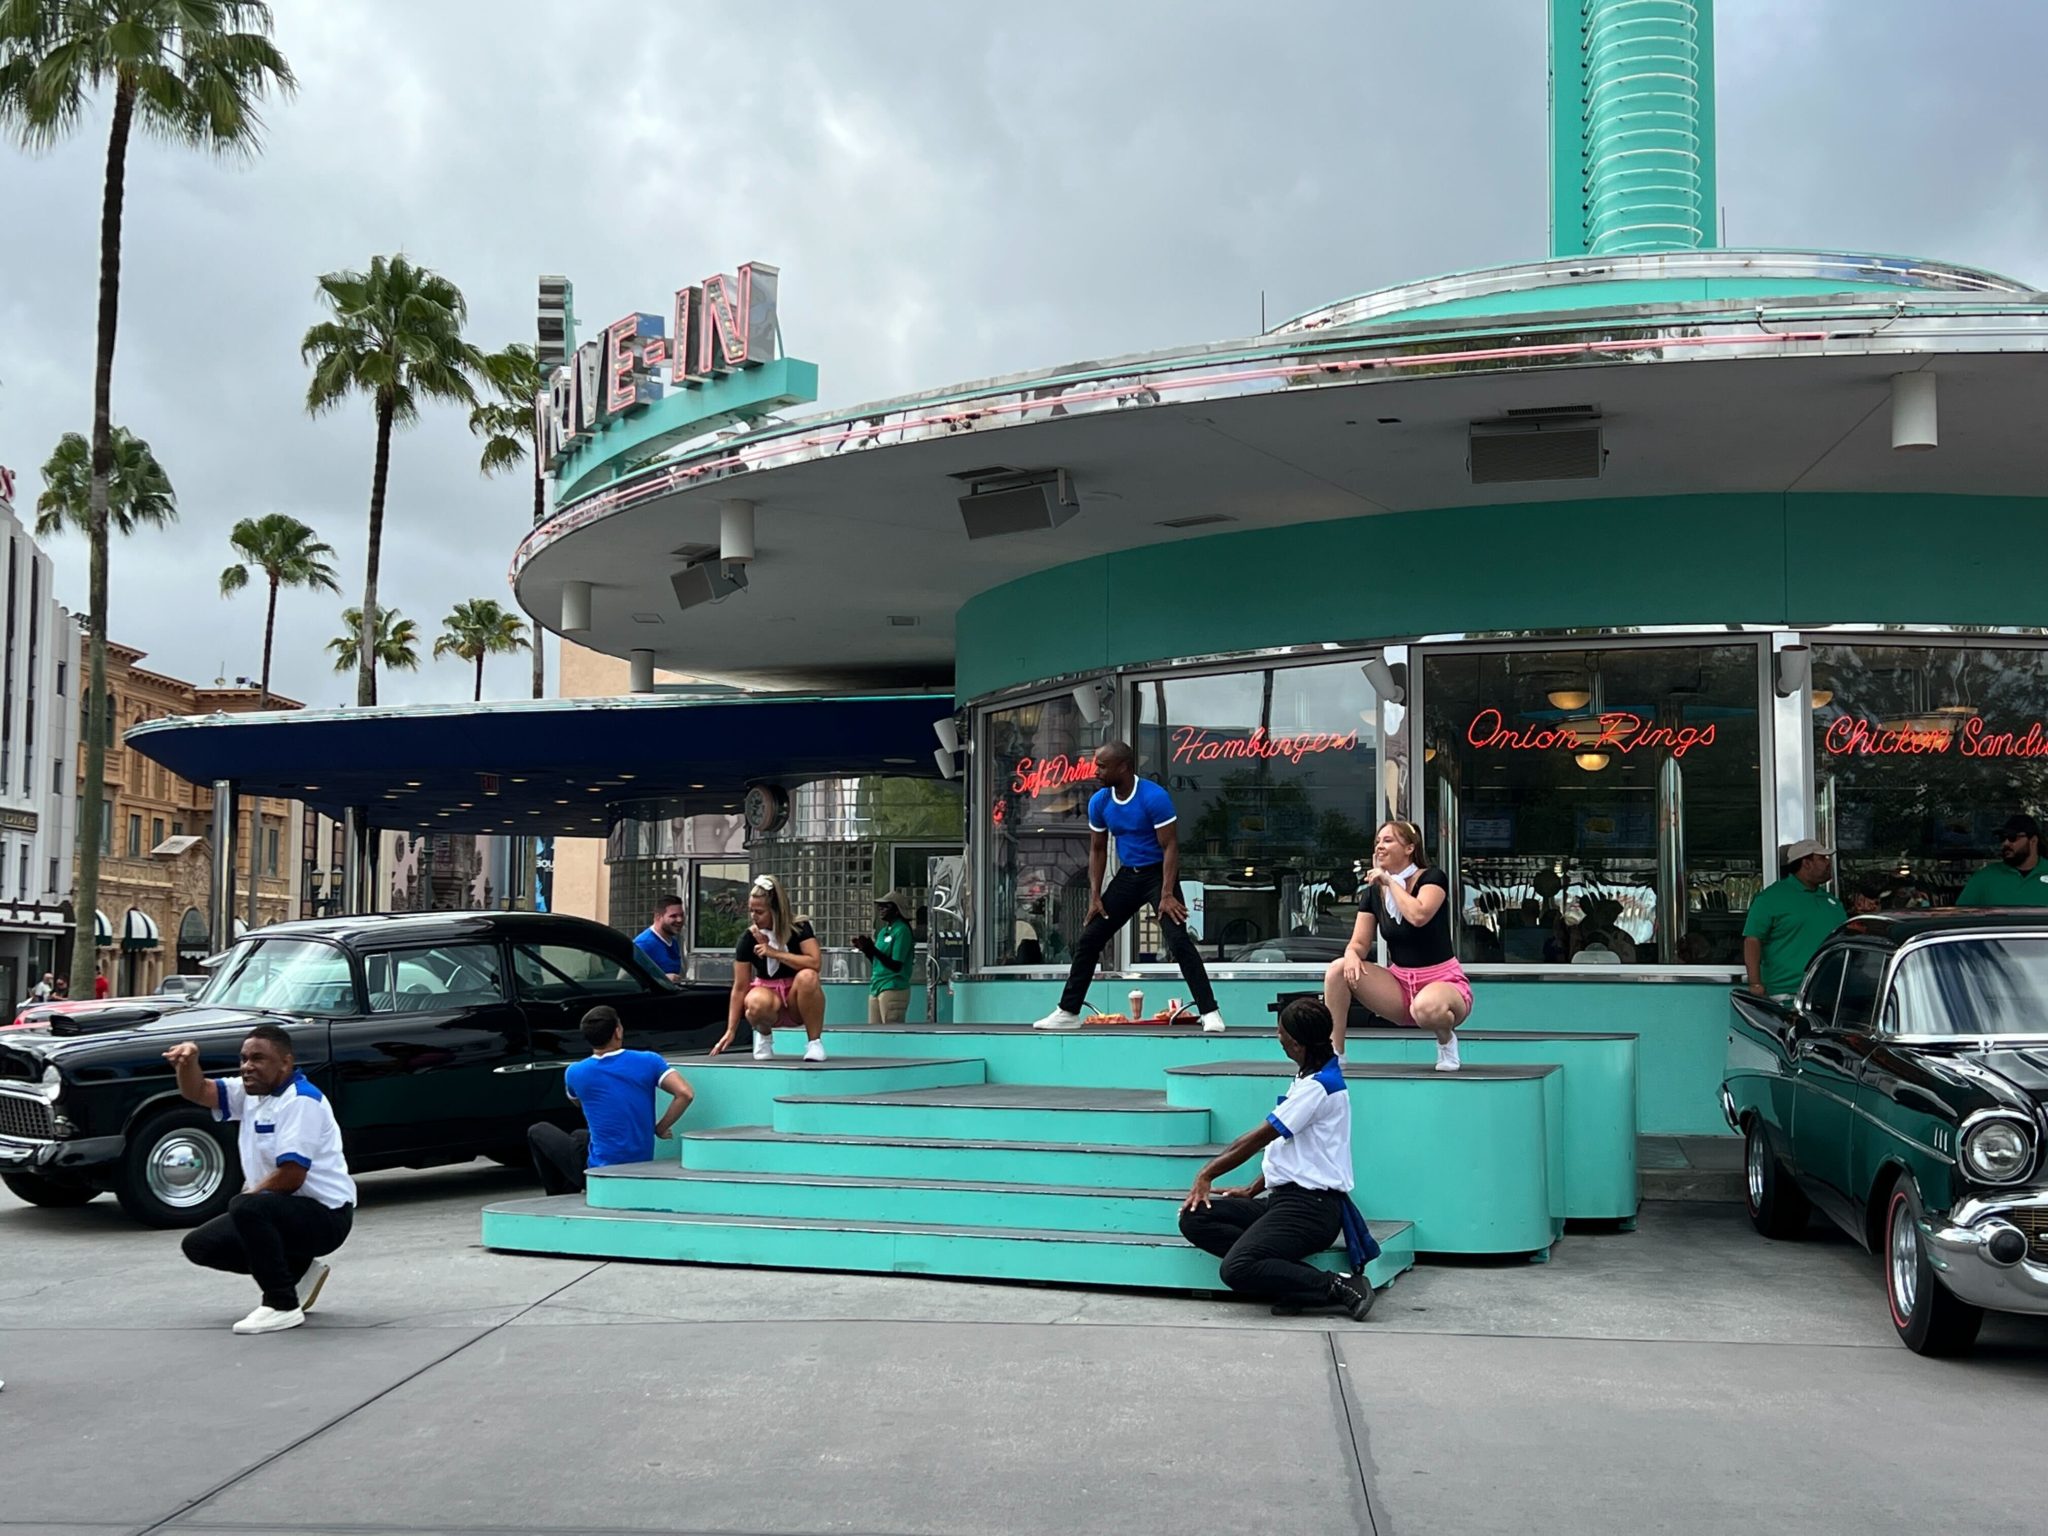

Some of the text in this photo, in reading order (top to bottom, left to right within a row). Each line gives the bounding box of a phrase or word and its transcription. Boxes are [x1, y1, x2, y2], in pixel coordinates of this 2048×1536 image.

[1171, 725, 1358, 765] Hamburgers
[1467, 708, 1717, 758] Onion Rings
[1825, 715, 1951, 755] Chicken
[1012, 757, 1051, 799] Soft
[1050, 753, 1099, 789] Drink
